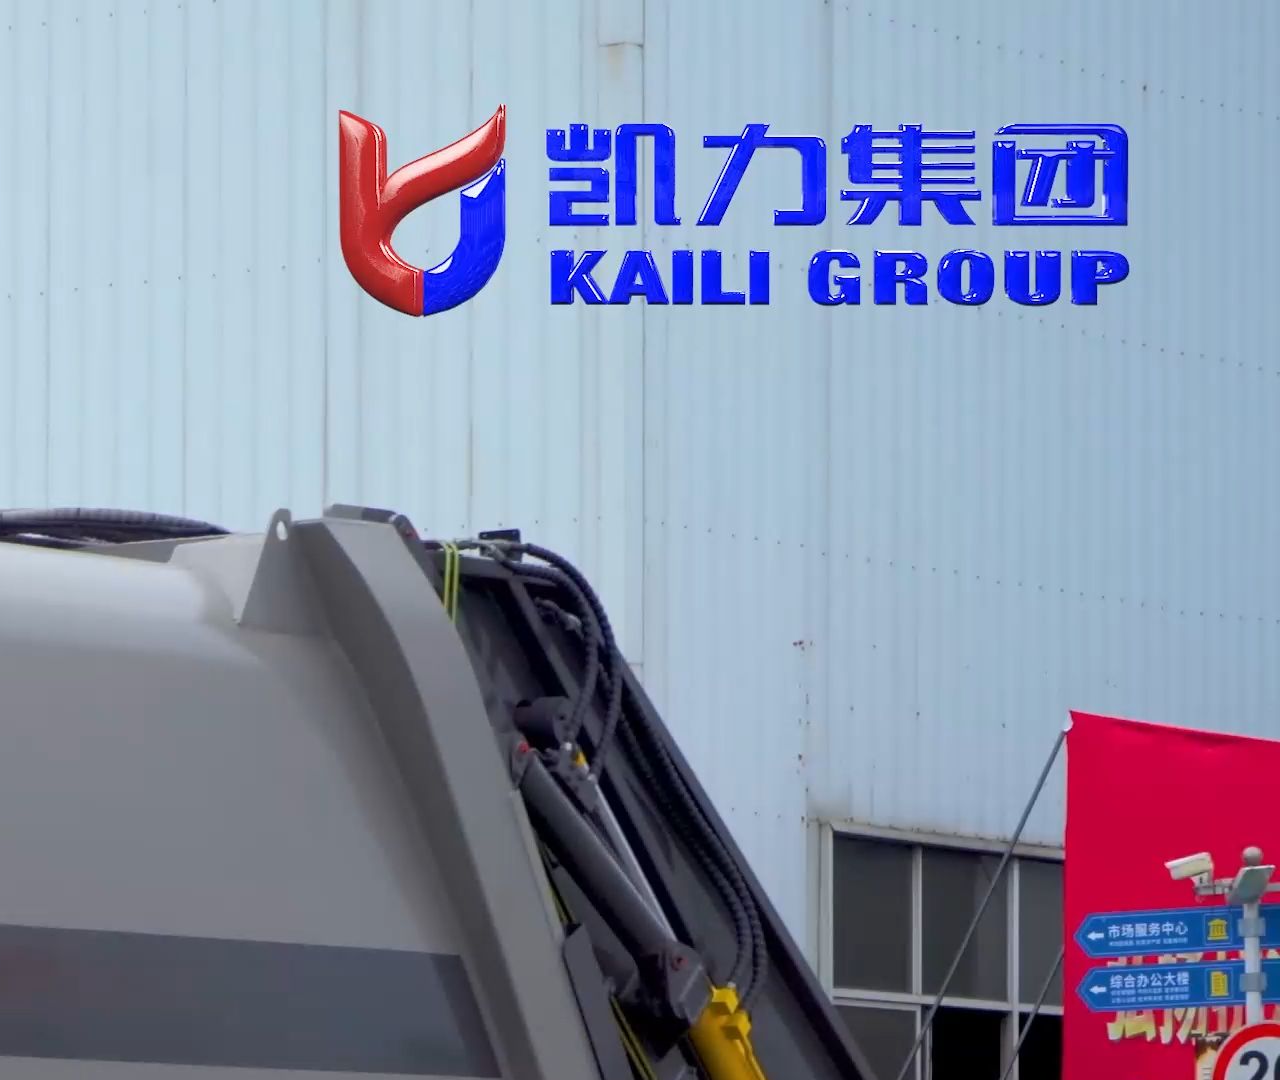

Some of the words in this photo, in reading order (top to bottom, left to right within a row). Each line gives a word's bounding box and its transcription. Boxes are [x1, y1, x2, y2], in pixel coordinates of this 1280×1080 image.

[1107, 921, 1188, 939] 市场服务中心
[1110, 971, 1189, 990] 综合办公大楼
